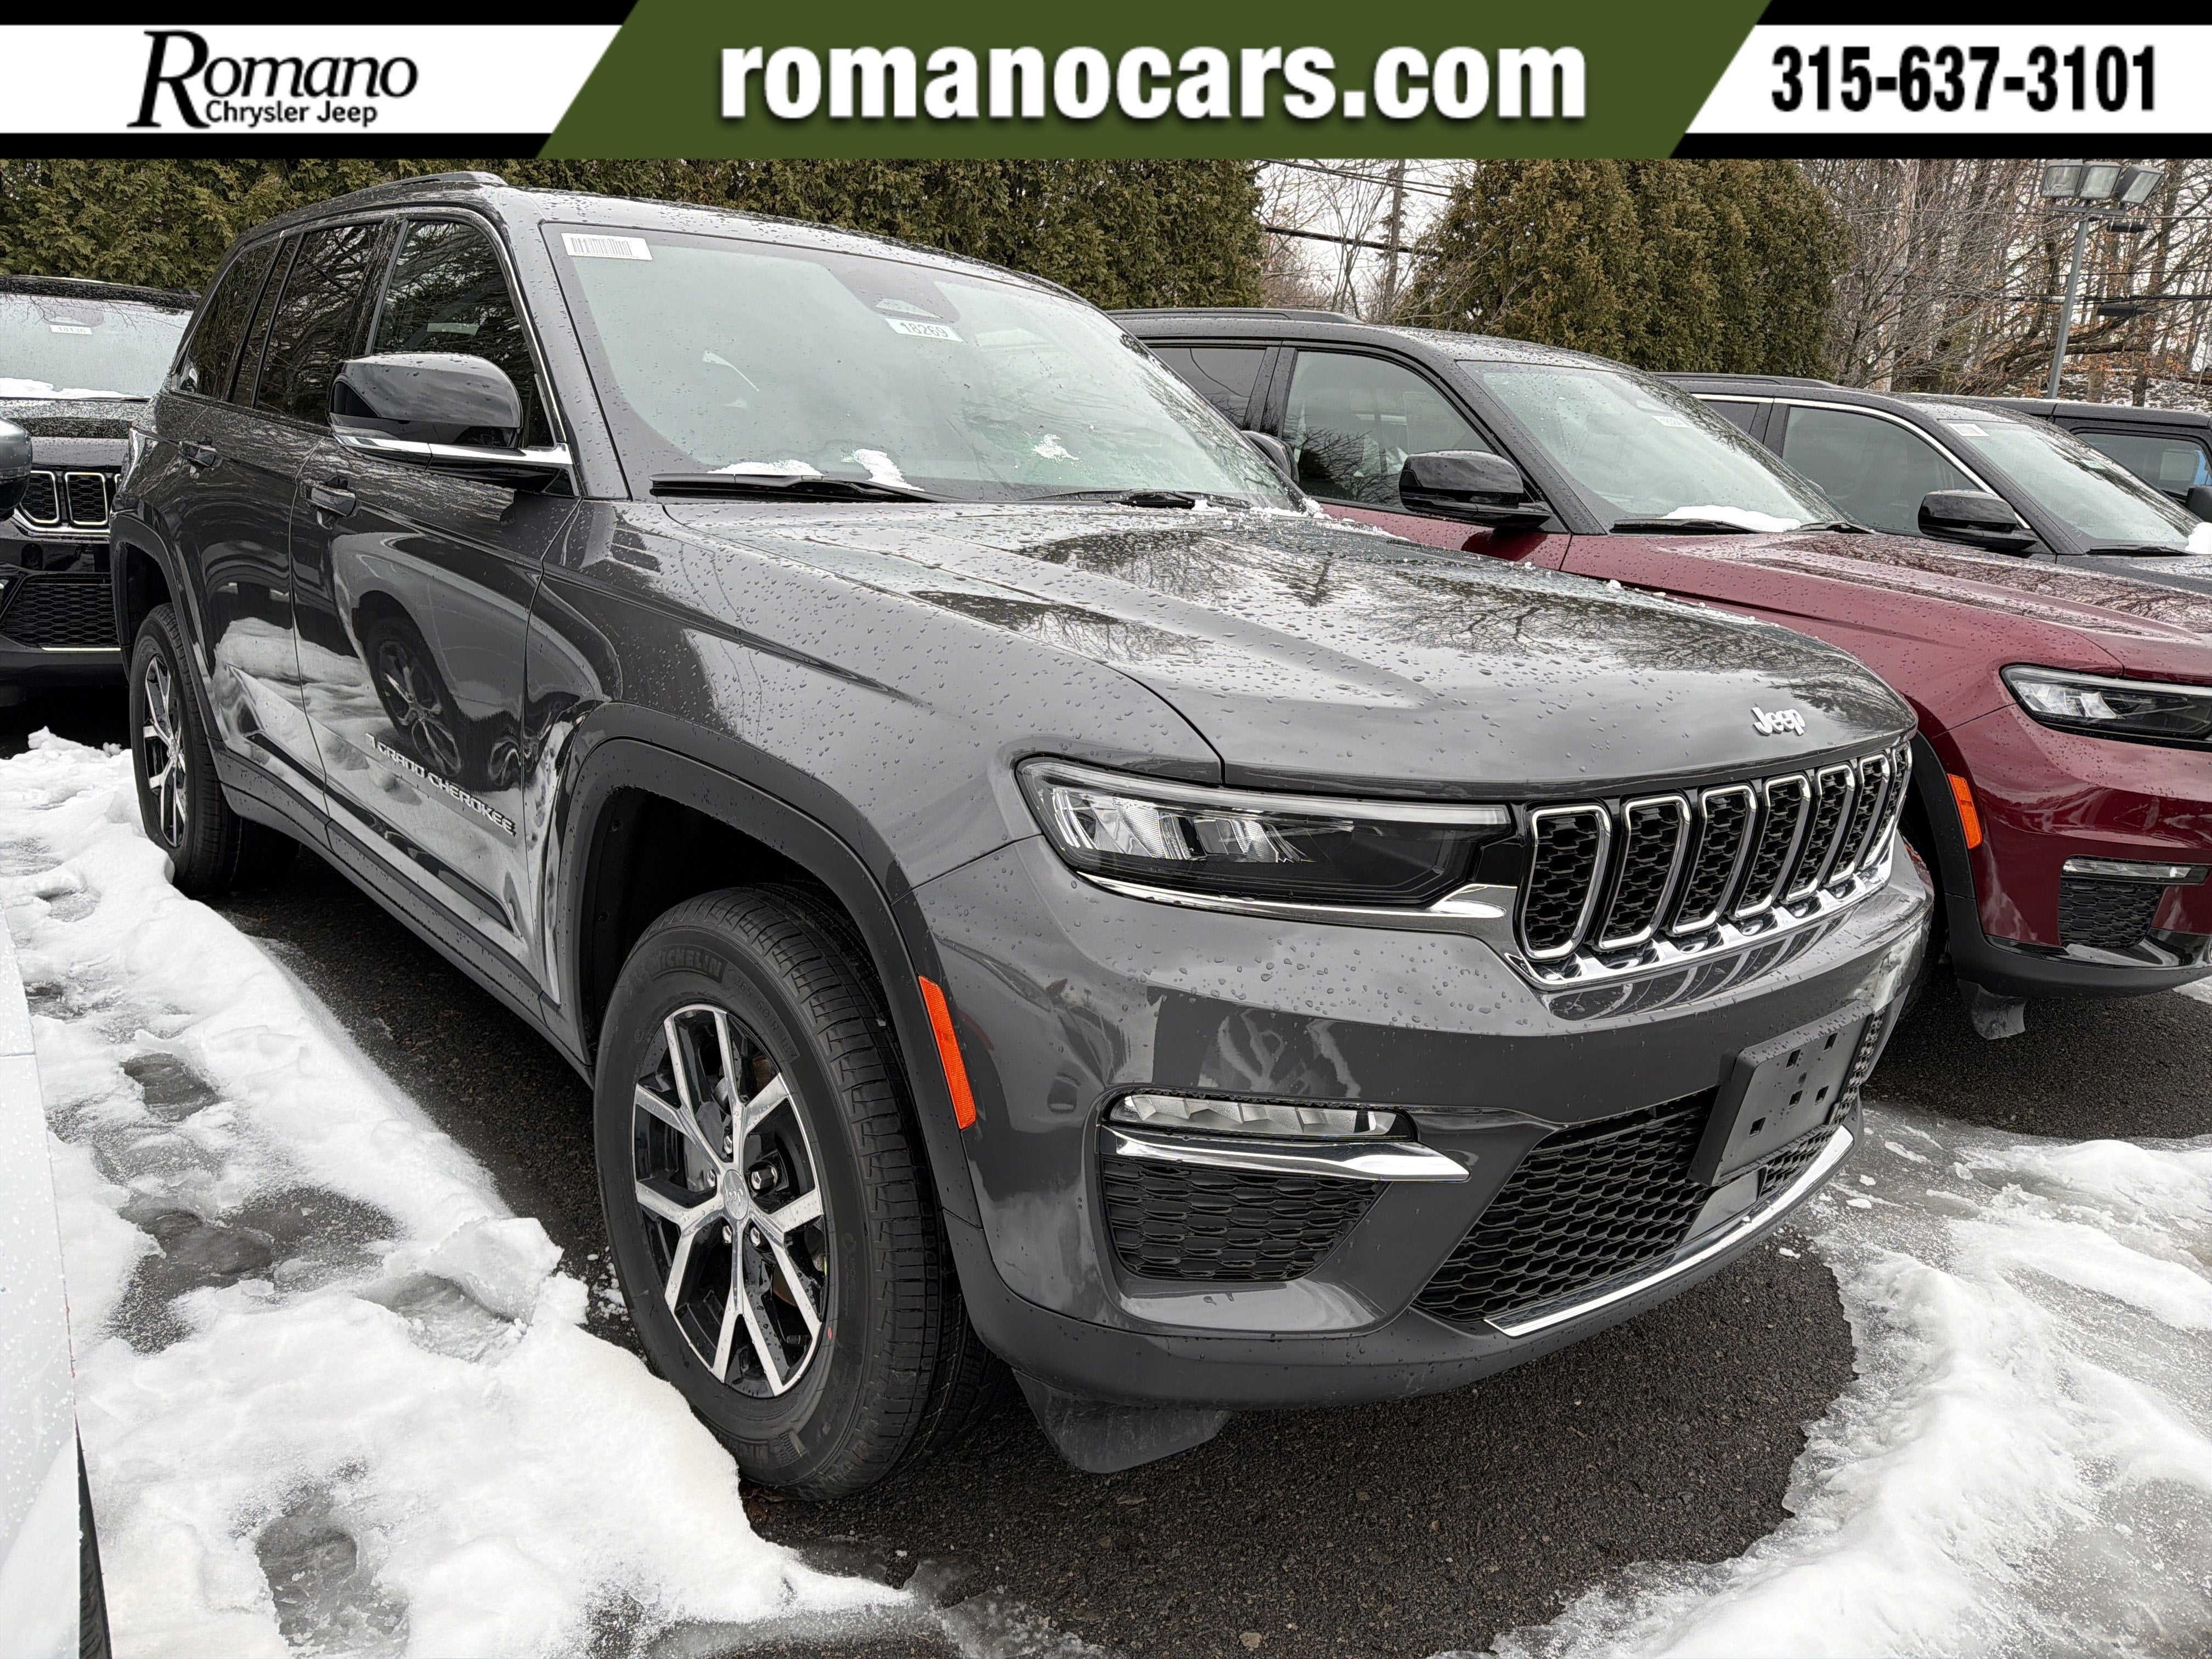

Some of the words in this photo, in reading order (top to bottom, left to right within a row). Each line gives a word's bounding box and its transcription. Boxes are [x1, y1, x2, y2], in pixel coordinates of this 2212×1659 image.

[900, 321, 949, 338] 18269
[1751, 707, 1806, 737] Jeep
[377, 741, 425, 779] GRAND
[427, 771, 517, 837] CHEROKEE
